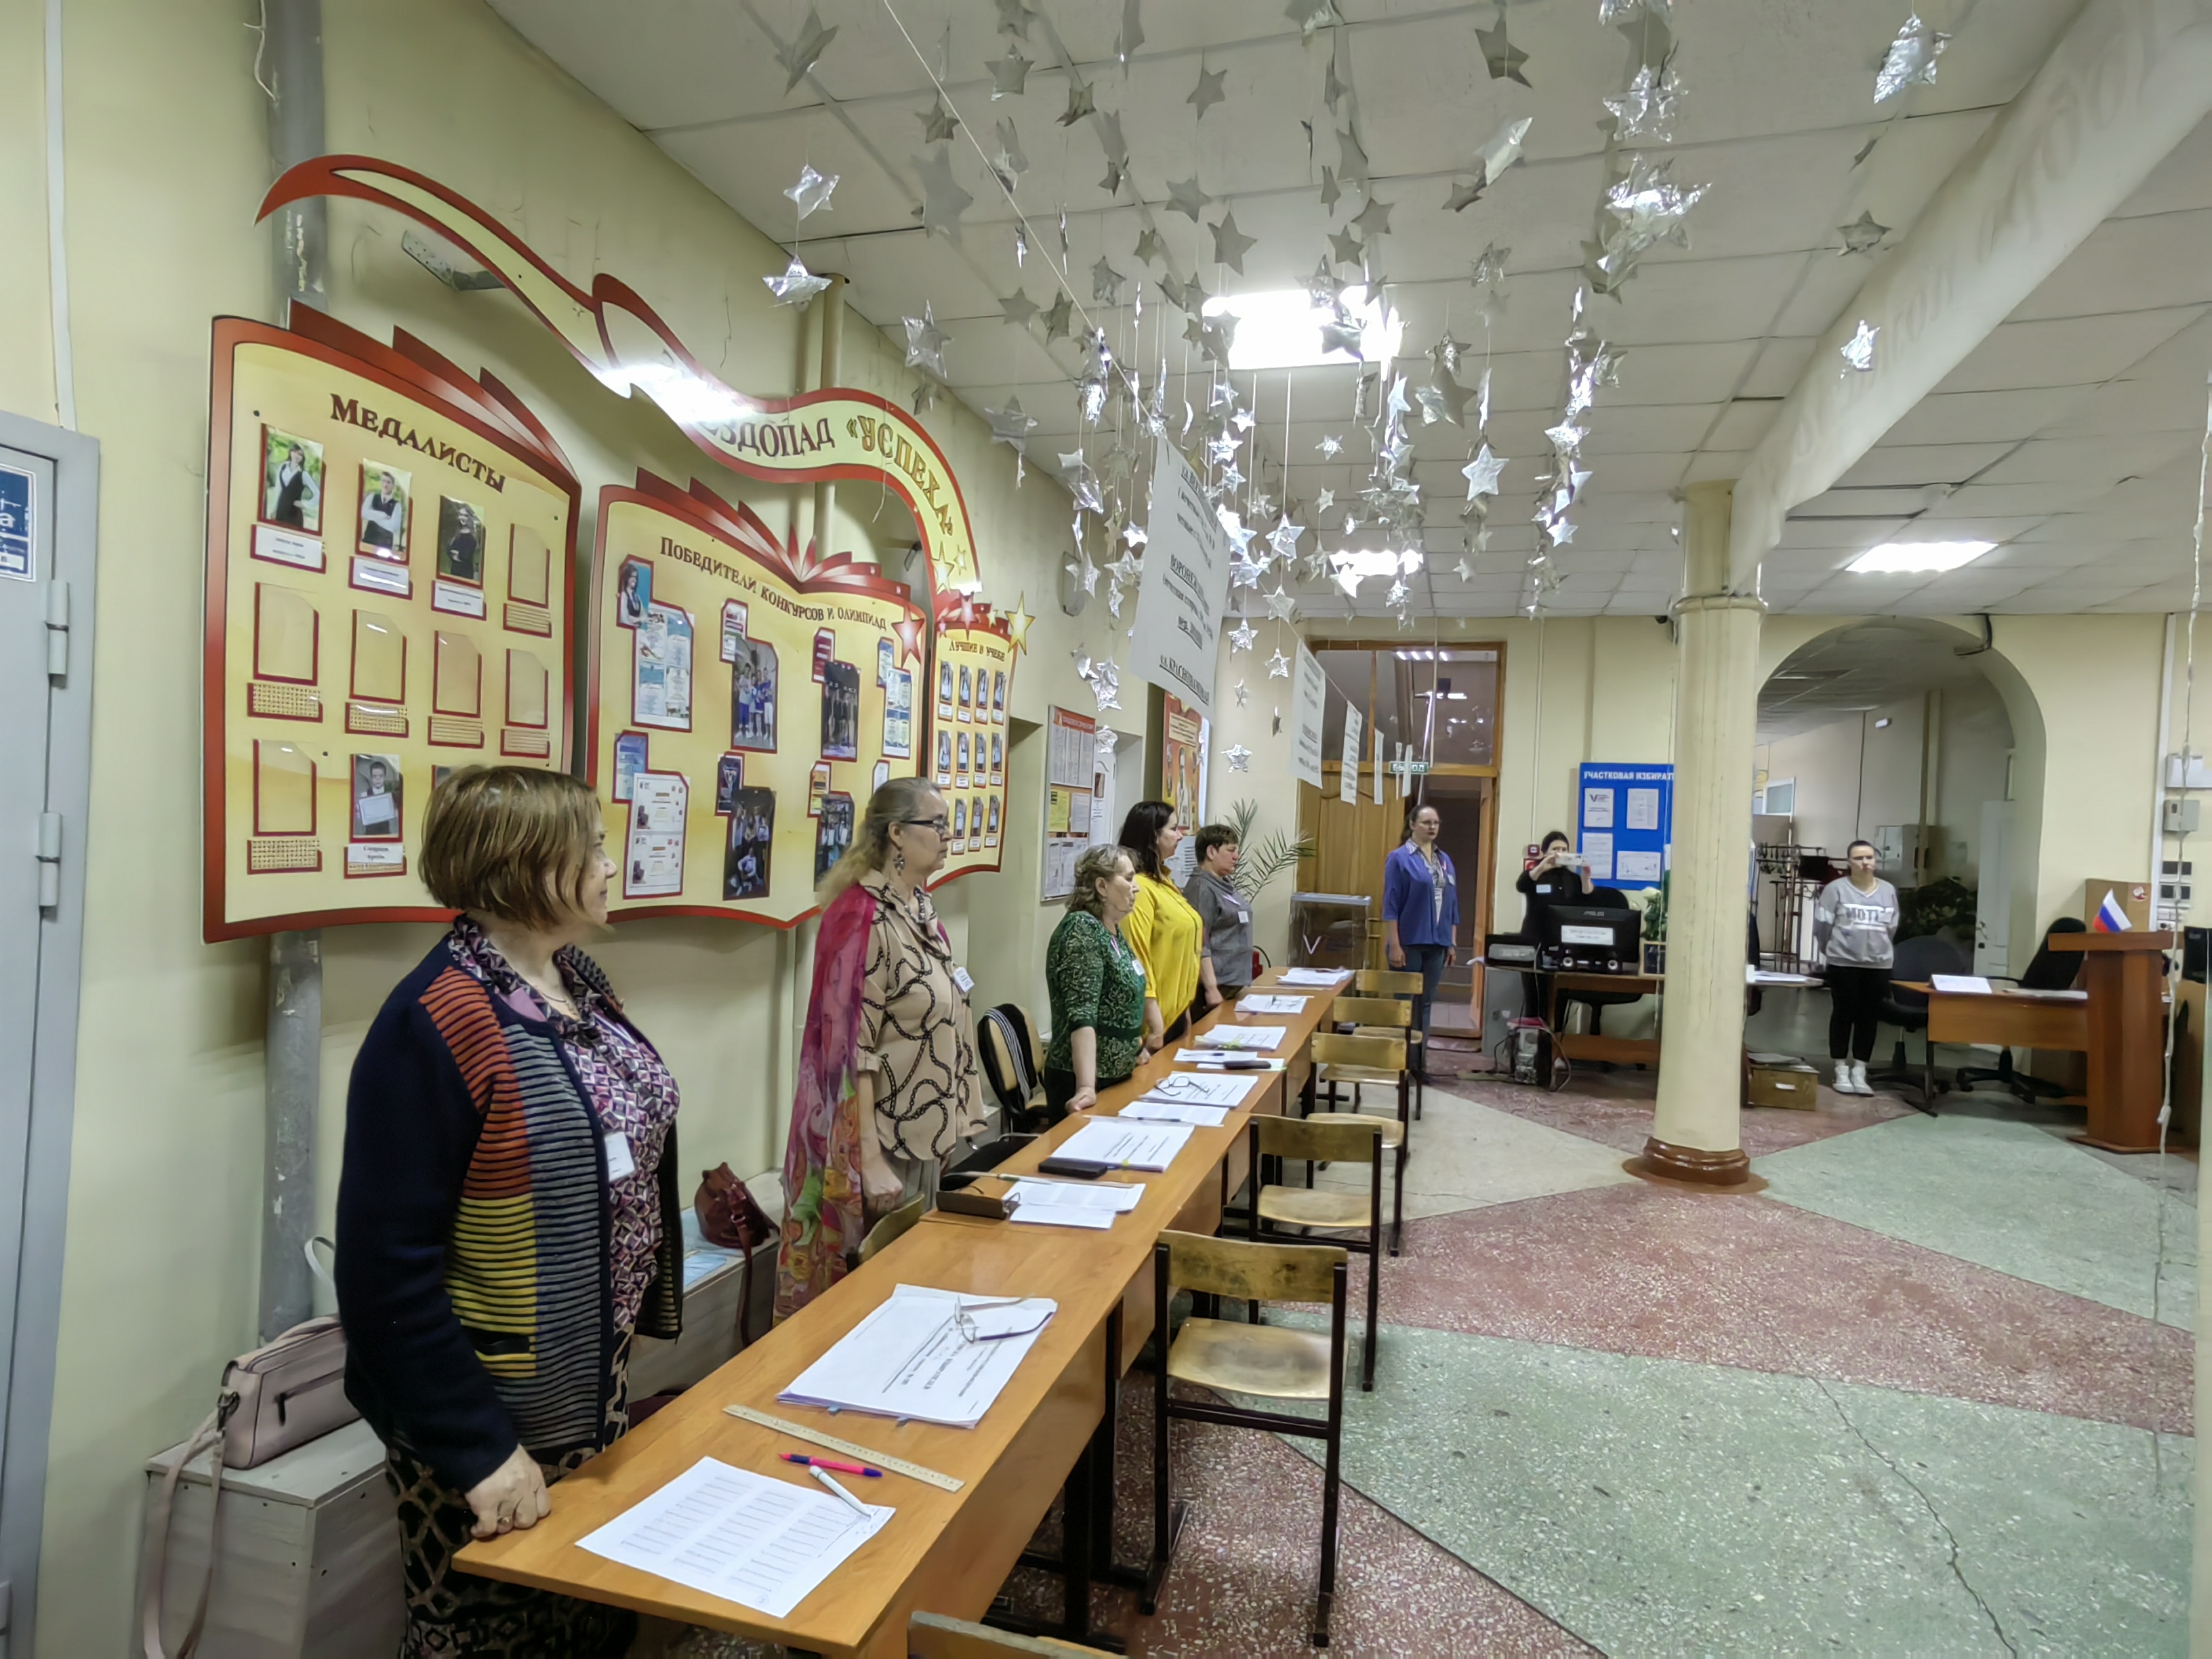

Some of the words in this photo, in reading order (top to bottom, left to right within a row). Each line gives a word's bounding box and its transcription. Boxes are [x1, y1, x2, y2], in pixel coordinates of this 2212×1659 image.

[760, 587, 824, 621] КОНКУРСОВ
[827, 607, 835, 621] И
[838, 607, 888, 630] ОЛИМПИАД
[1584, 771, 1634, 780] УЧАСТКОВАЯ
